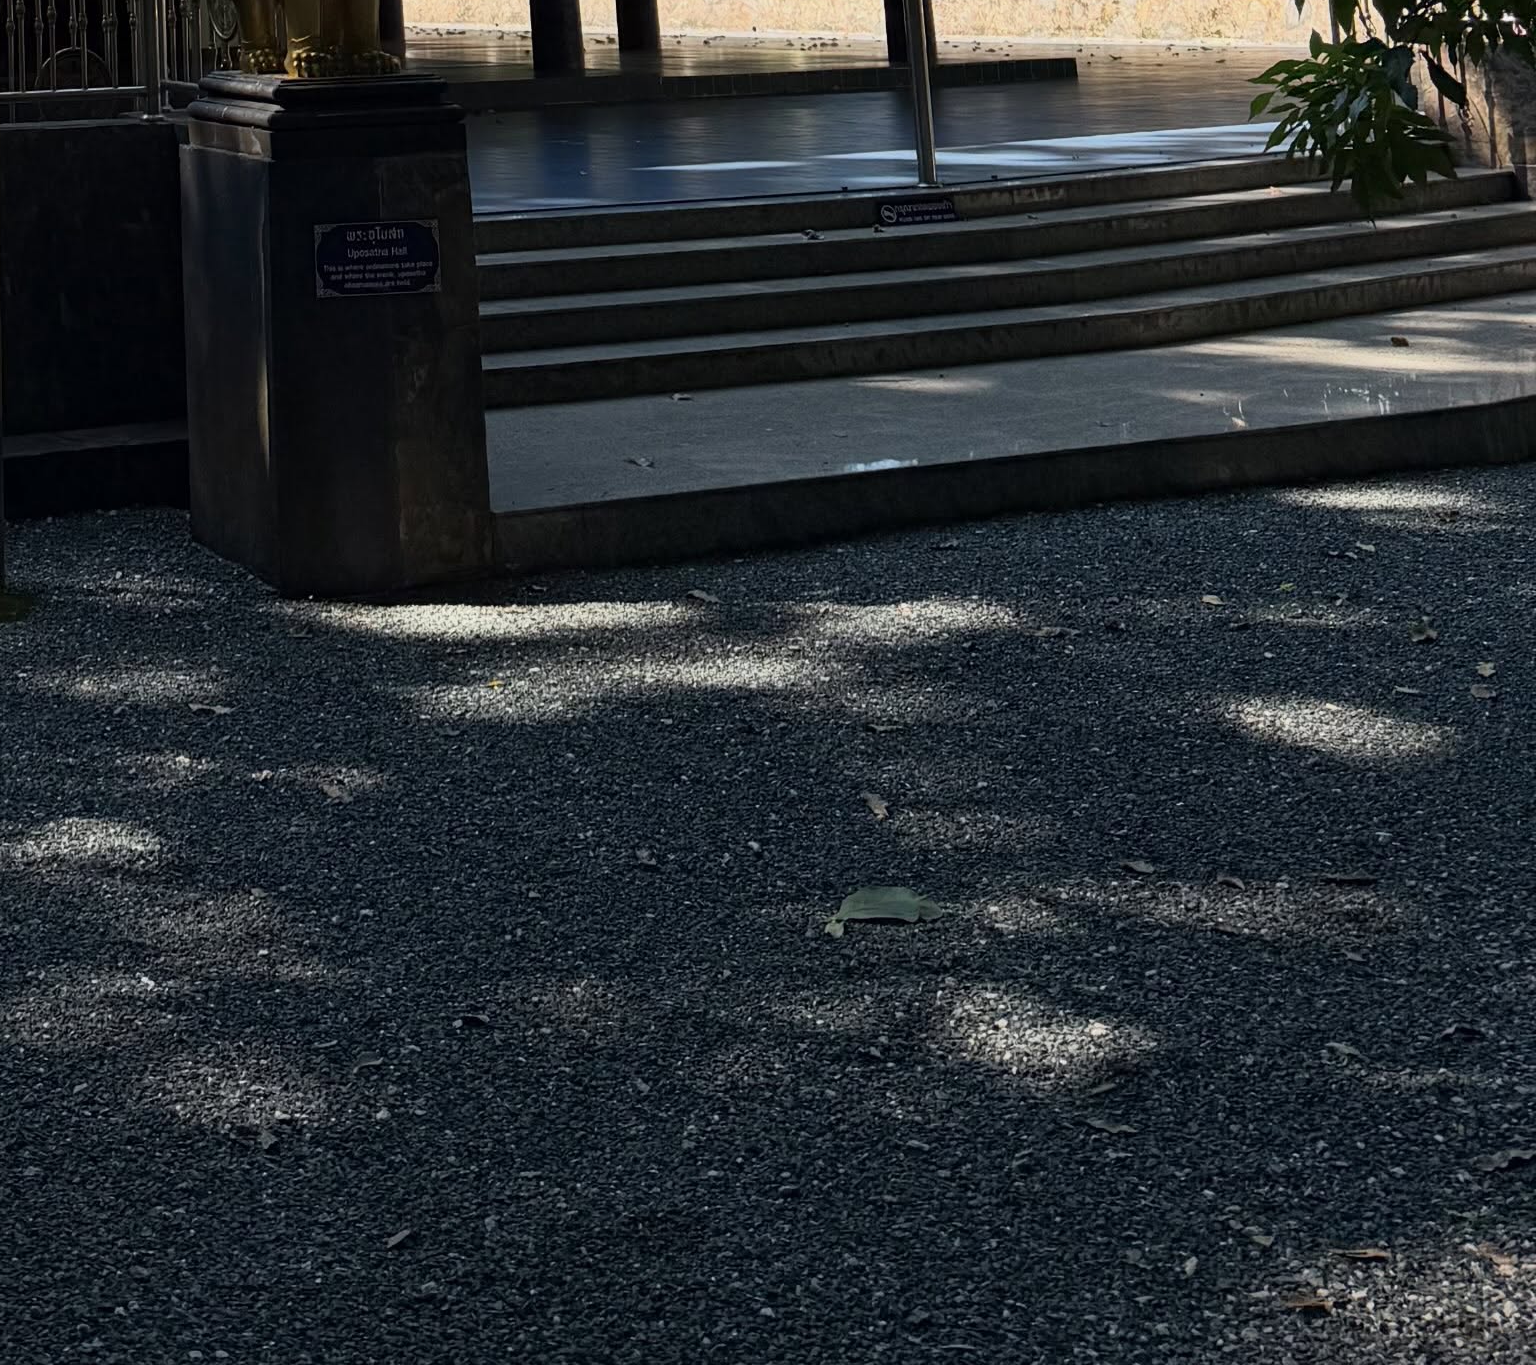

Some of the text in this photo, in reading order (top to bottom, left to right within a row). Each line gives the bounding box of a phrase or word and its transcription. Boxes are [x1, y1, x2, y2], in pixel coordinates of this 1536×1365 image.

[346, 226, 404, 244] พระอุโบสถ
[391, 246, 408, 256] Hall
